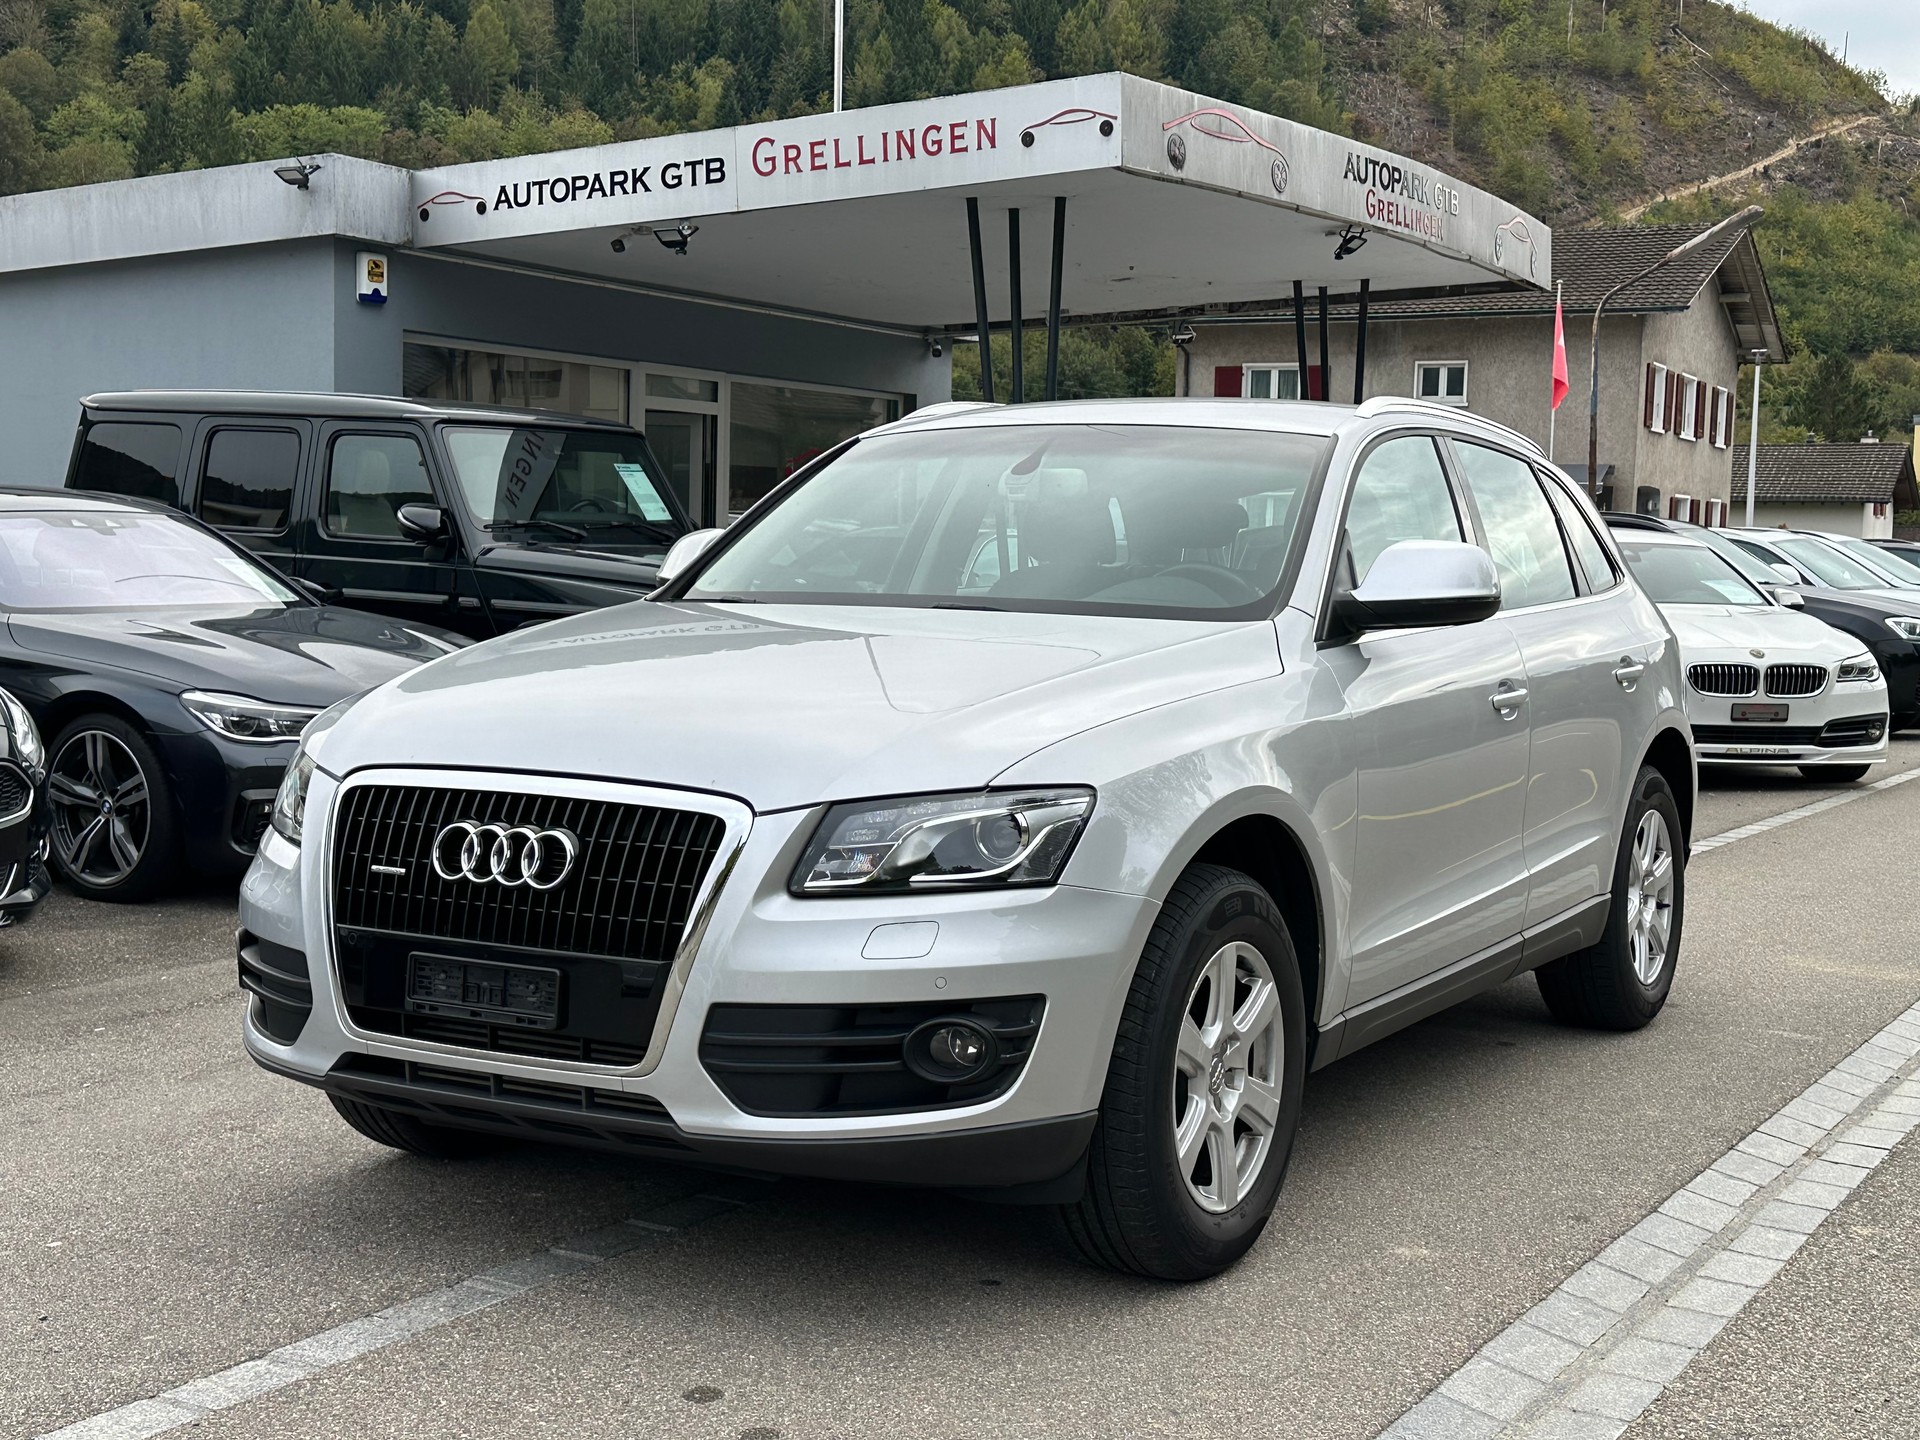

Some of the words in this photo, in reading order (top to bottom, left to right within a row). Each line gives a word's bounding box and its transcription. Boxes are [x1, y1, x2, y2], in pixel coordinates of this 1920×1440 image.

[493, 166, 652, 211] AUTOPARK
[660, 157, 726, 190] GTB
[752, 117, 997, 177] GRELLINGEN
[1343, 152, 1430, 206] AUTOPARK
[1434, 182, 1459, 216] GTB
[1365, 189, 1443, 241] GRELLINGEN
